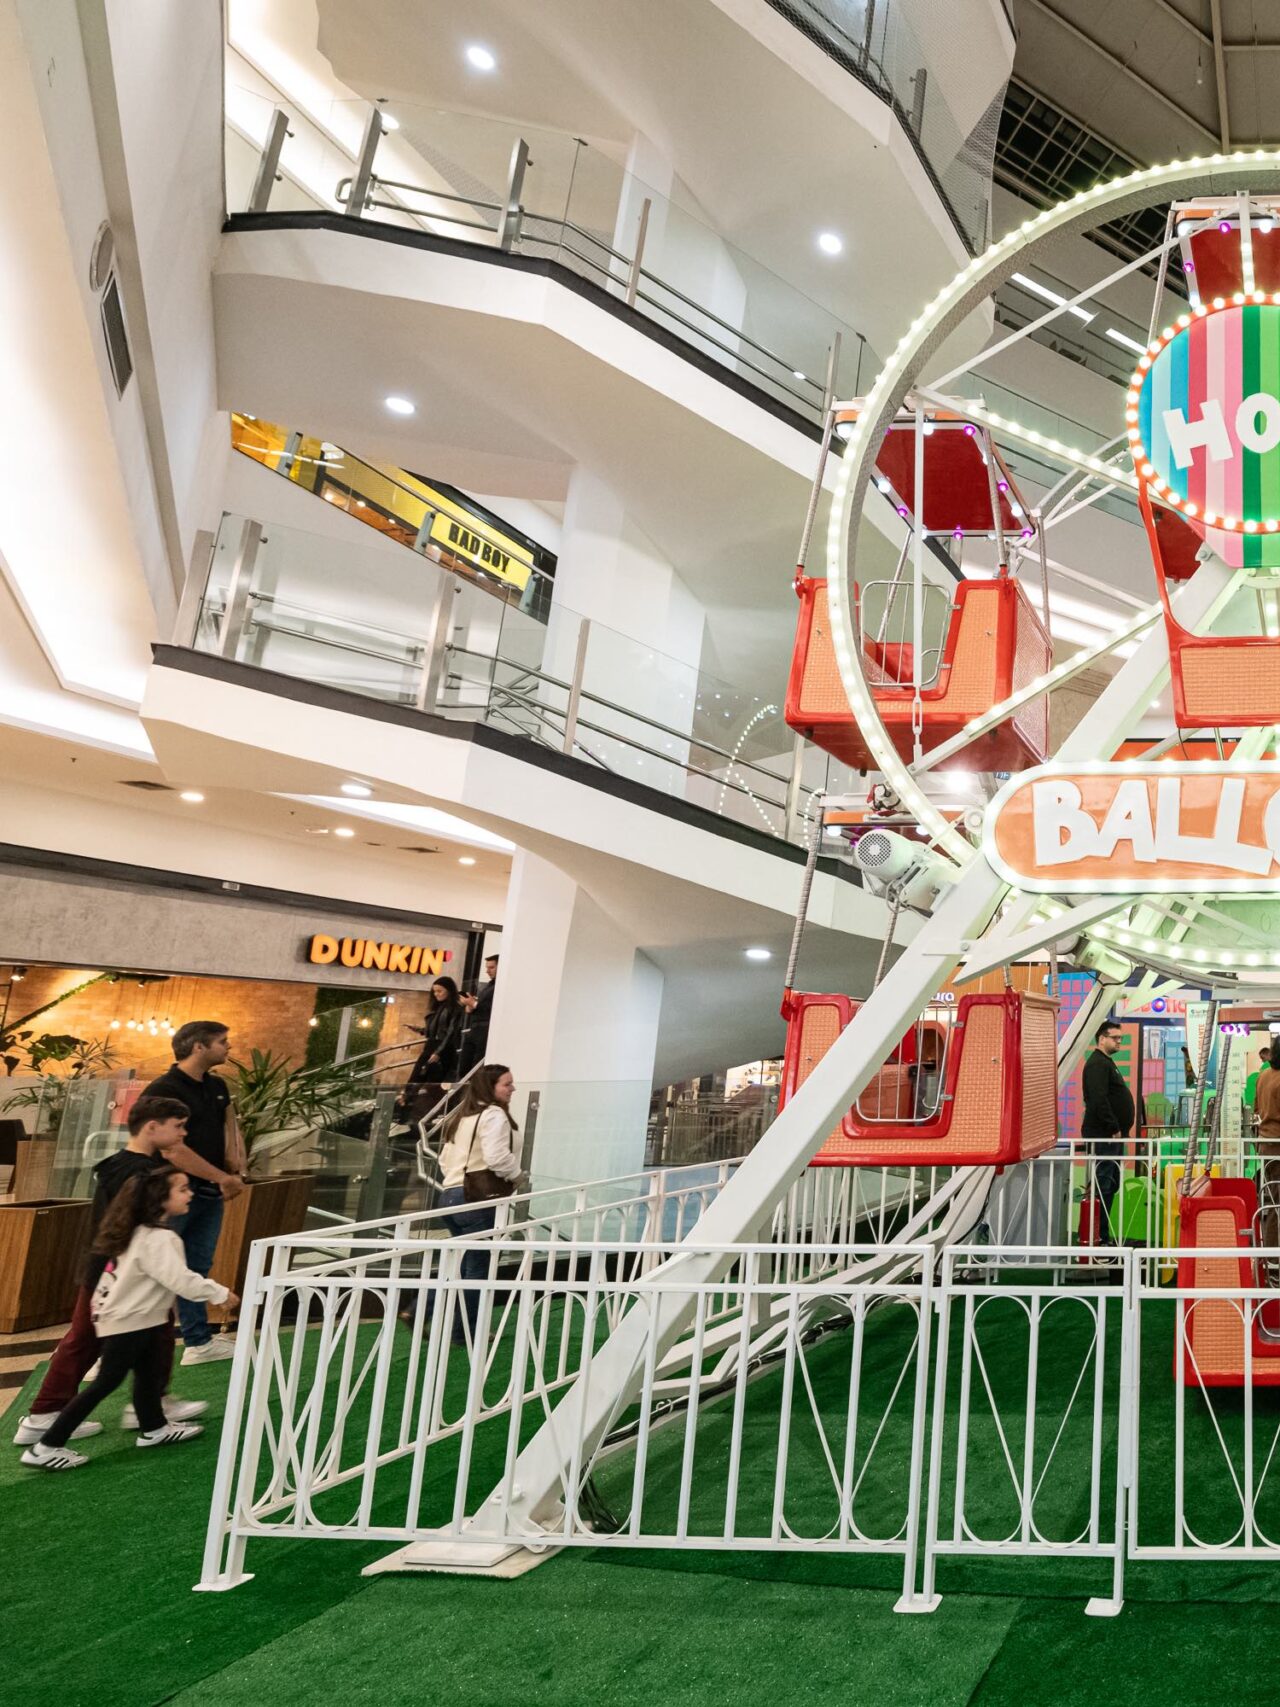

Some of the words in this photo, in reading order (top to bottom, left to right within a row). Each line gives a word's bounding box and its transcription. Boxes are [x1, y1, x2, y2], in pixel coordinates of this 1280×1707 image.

[448, 522, 481, 556] BAD
[481, 542, 511, 573] BOY
[310, 933, 453, 976] DUNKIN'
